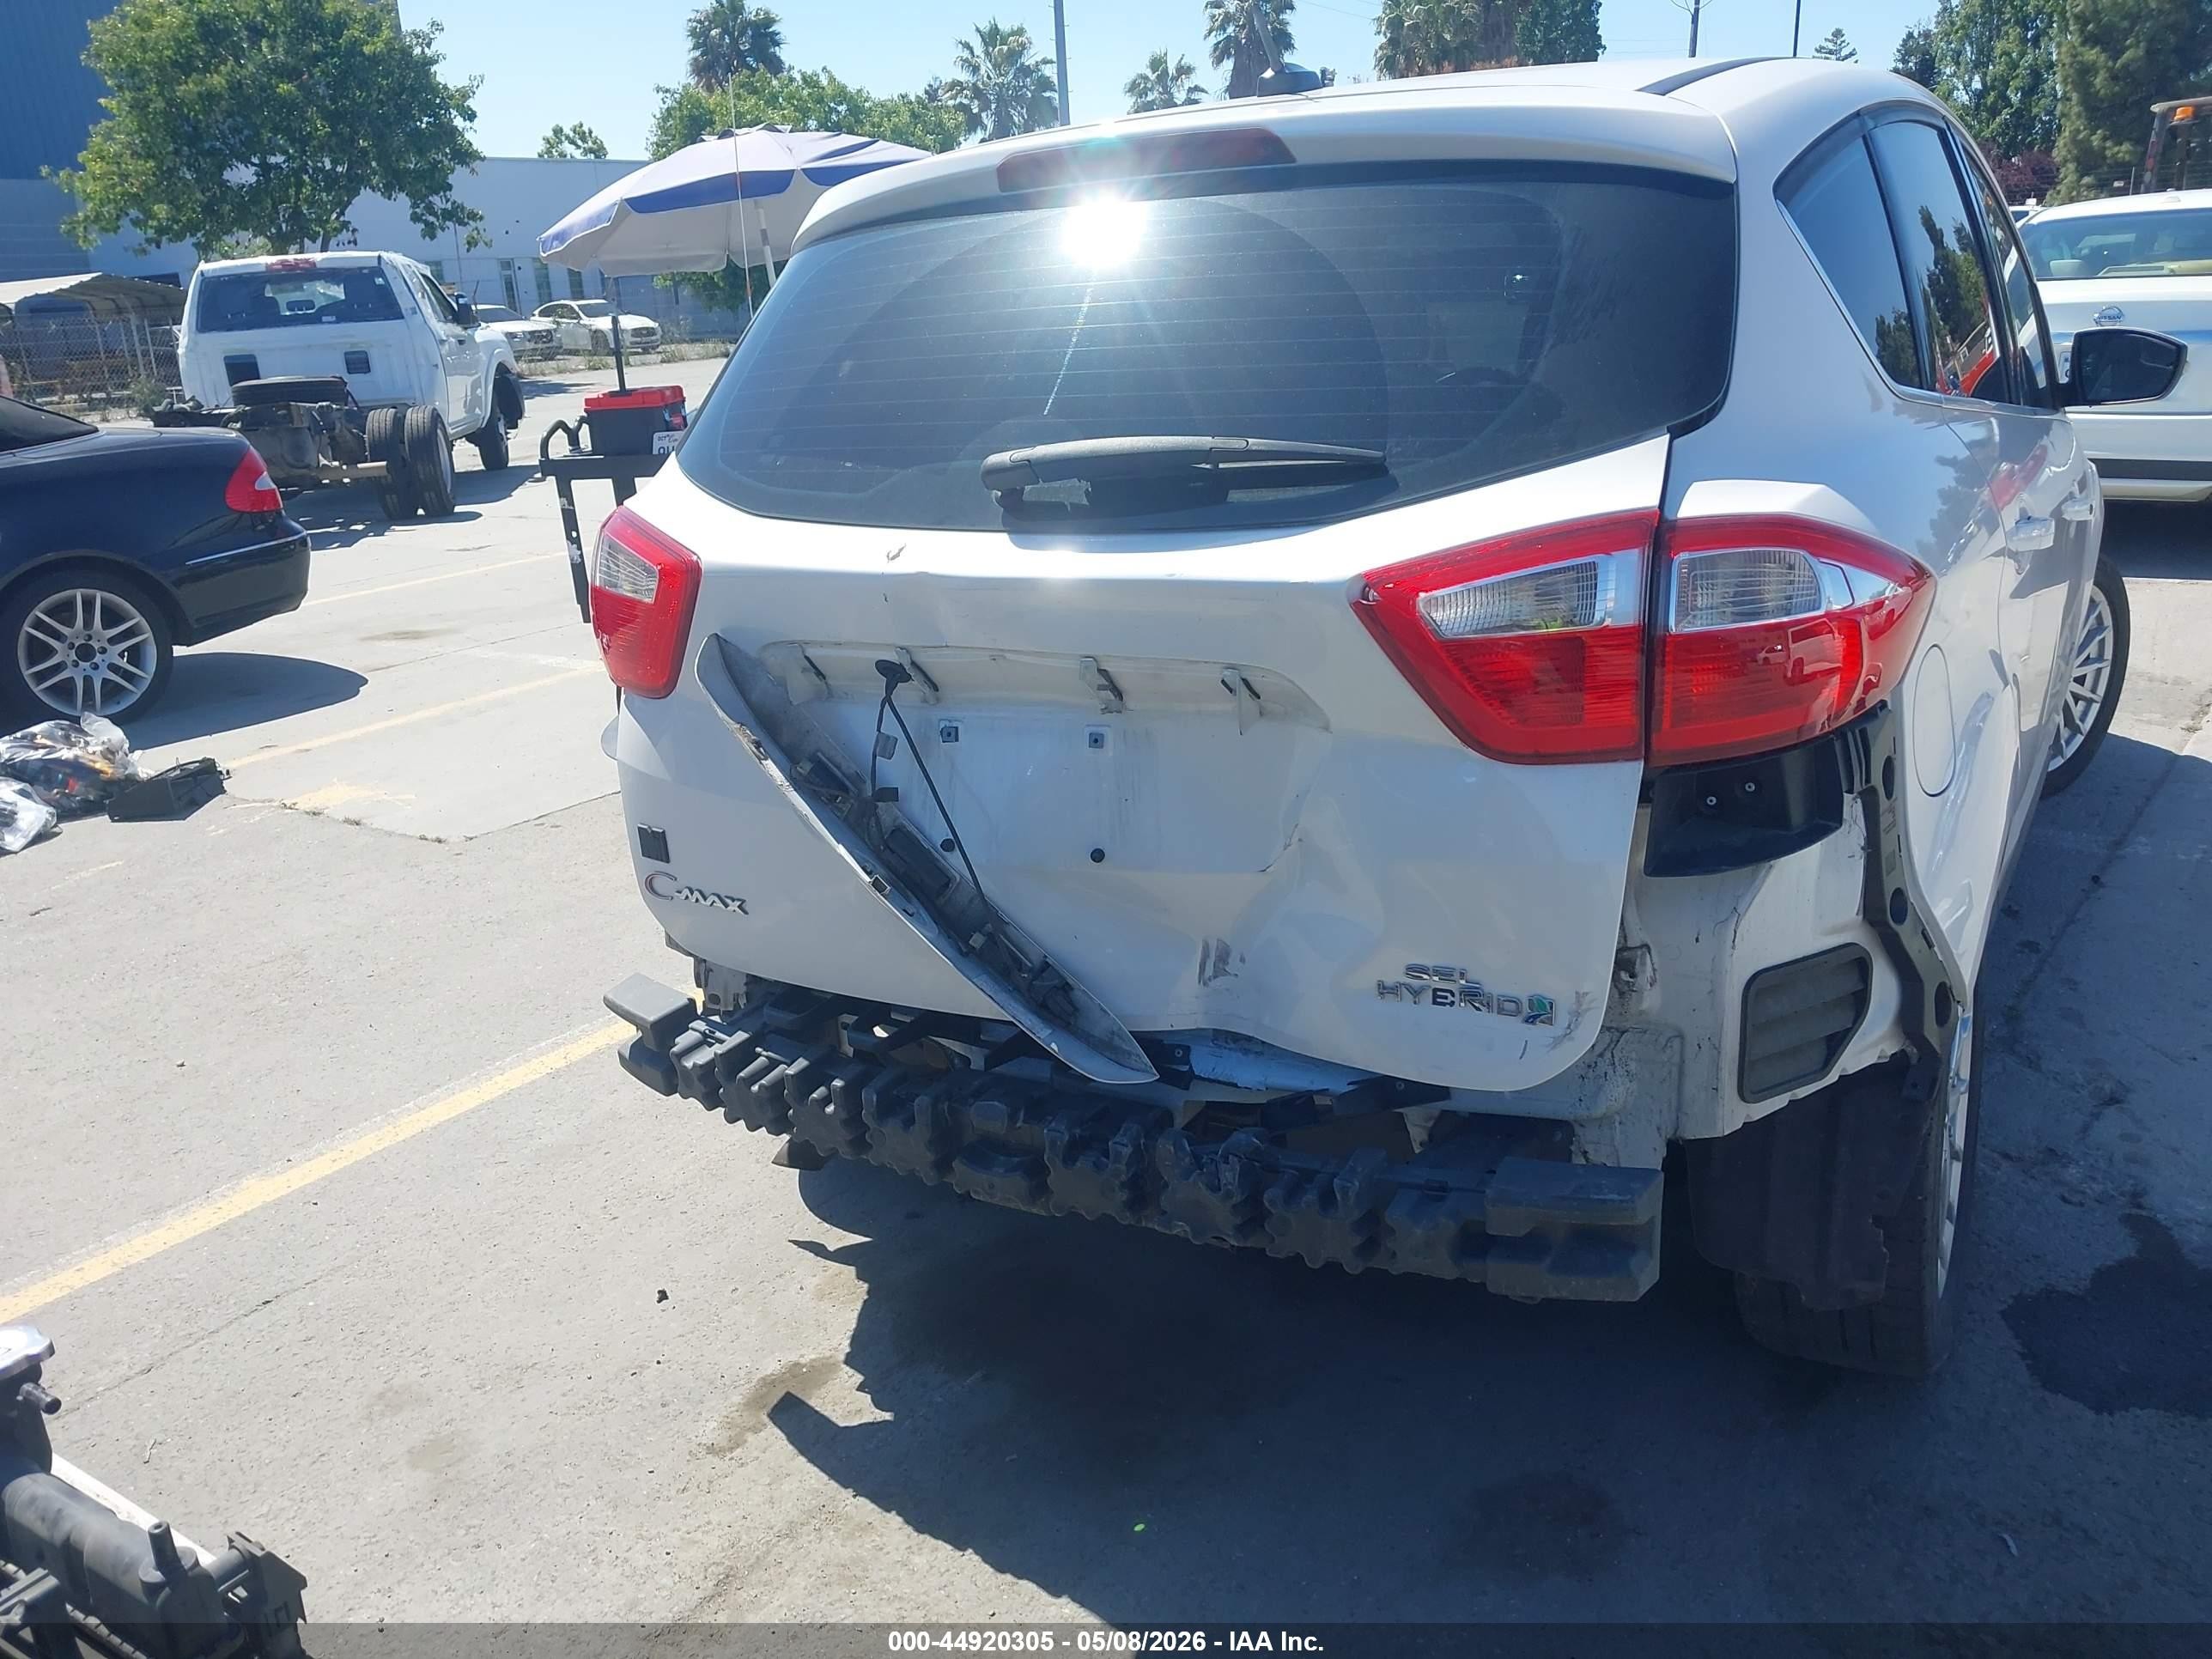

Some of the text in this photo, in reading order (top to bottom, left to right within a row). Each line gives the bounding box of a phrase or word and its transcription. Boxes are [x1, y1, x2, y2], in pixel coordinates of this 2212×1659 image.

[644, 871, 749, 915] C-MAX
[1404, 963, 1482, 988] SEL
[1376, 980, 1523, 1017] HYBRID
